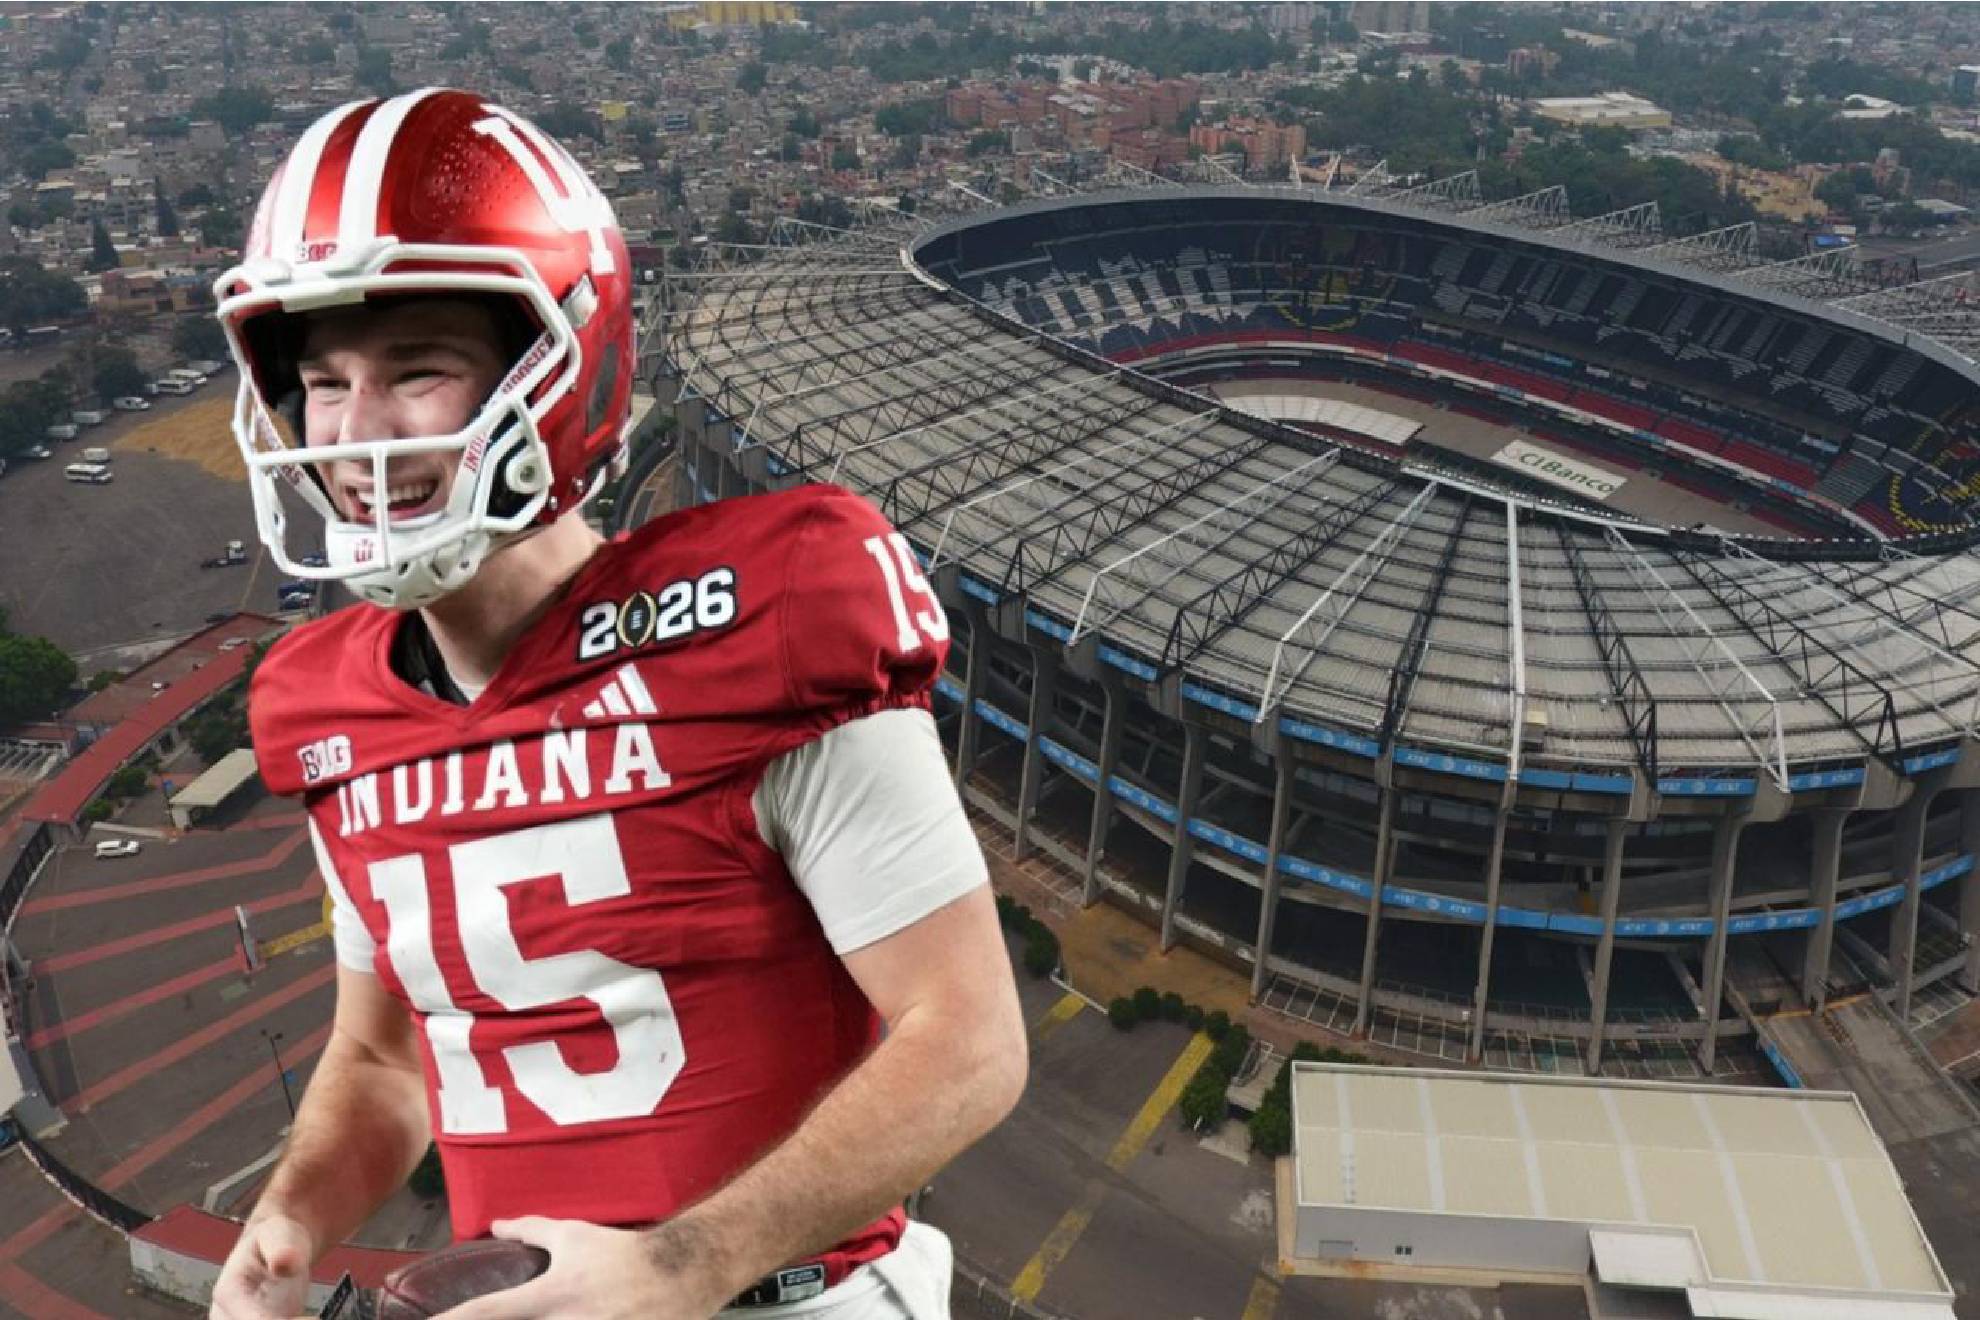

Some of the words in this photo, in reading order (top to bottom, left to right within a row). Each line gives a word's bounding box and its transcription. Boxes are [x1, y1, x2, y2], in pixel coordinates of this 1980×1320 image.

[578, 566, 736, 661] 2026
[862, 532, 951, 654] 15
[338, 722, 672, 837] INDIANA
[367, 811, 687, 1135] 15
